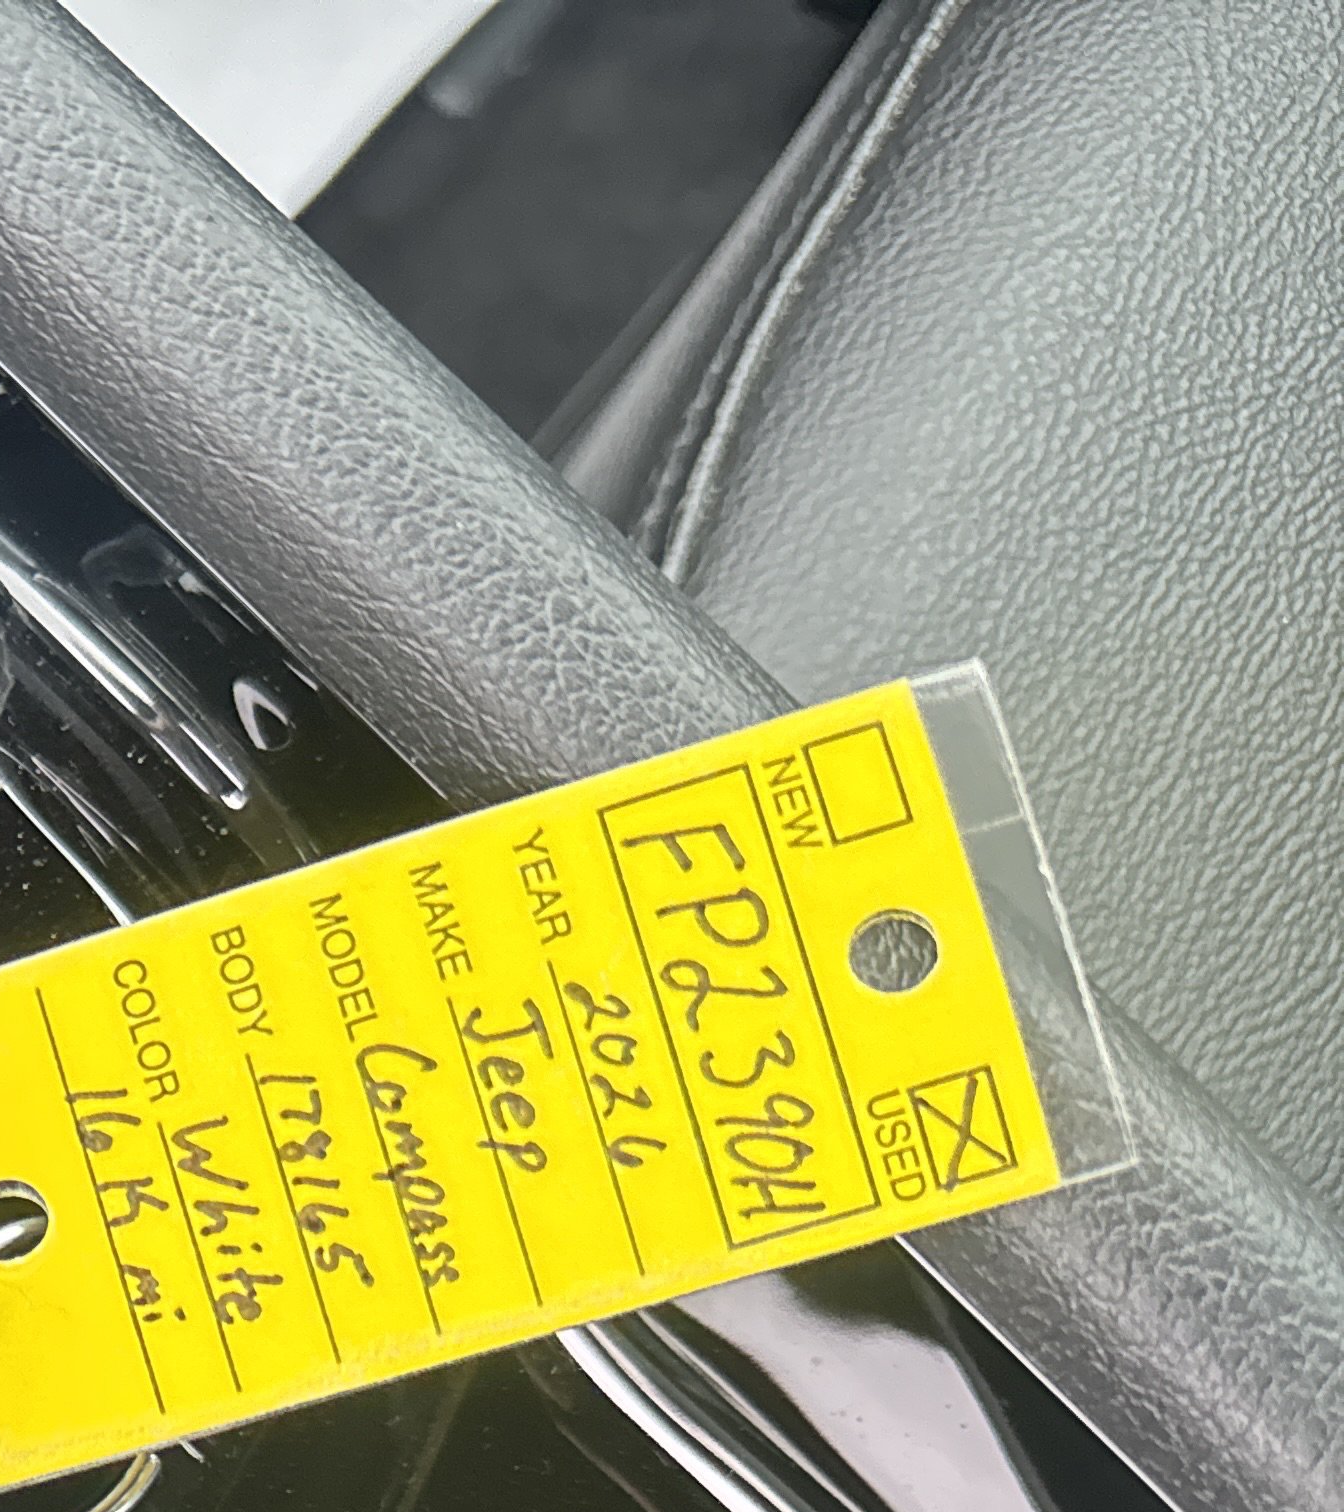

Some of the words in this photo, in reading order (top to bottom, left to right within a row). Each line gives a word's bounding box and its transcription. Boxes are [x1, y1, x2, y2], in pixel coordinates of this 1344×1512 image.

[761, 754, 824, 851] NEW
[112, 958, 181, 1104] COLOR
[170, 1114, 284, 1326] White
[210, 924, 274, 1038] BODY
[308, 892, 379, 1043] MODEL
[355, 1042, 460, 1289] Compass
[407, 860, 474, 982] MAKE
[460, 997, 555, 1174] Jeep
[512, 826, 573, 946] YEAR
[562, 980, 668, 1169] 2026
[621, 823, 827, 1222] FP2390H
[866, 1088, 927, 1202] USED
